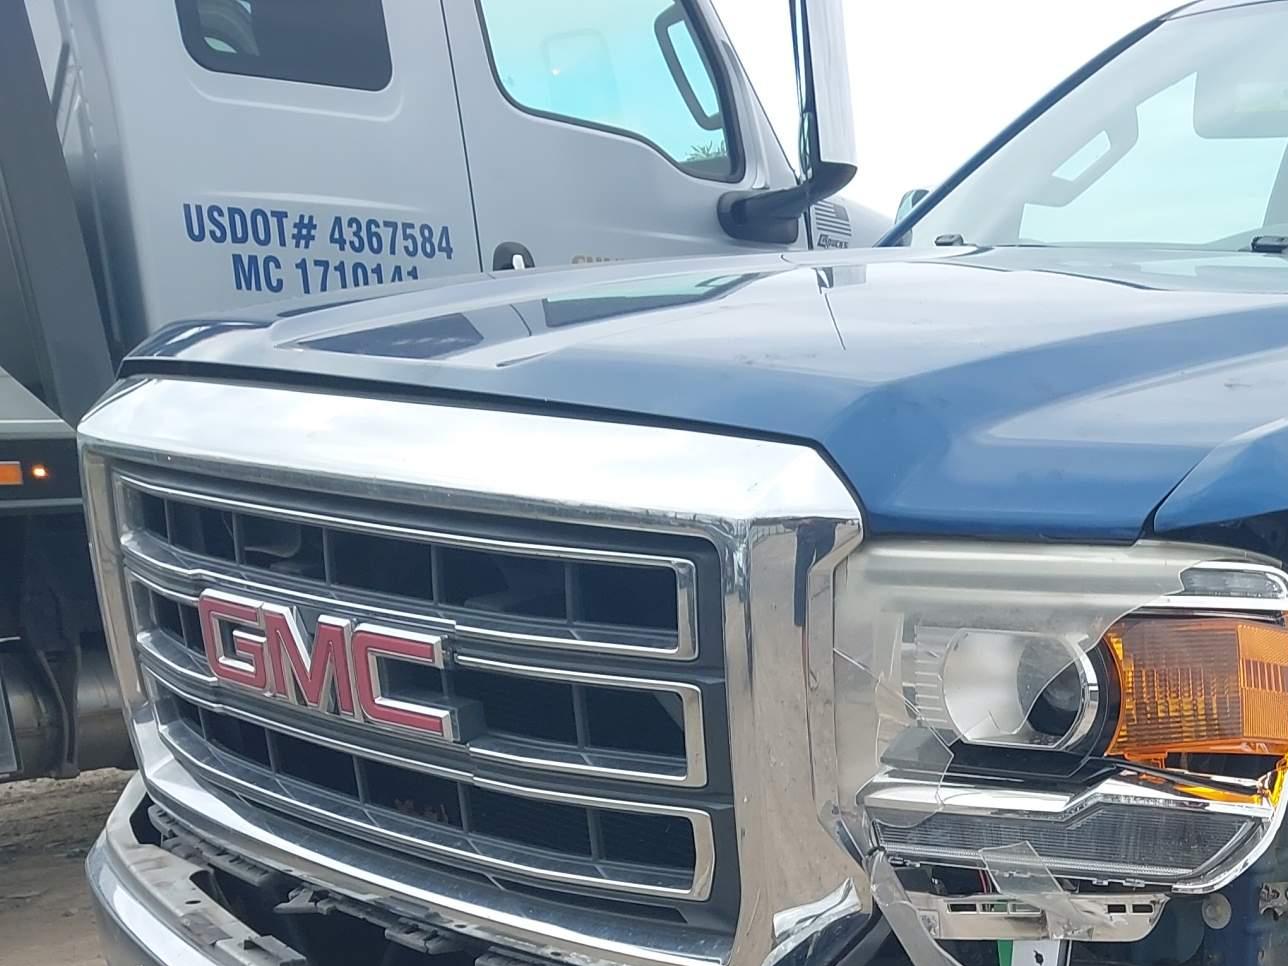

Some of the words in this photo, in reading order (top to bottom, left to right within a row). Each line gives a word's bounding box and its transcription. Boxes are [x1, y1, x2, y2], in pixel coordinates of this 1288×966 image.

[183, 203, 317, 249] USDOT#
[329, 216, 454, 260] 4367584
[232, 254, 284, 293] MC
[199, 588, 455, 743] GMC
